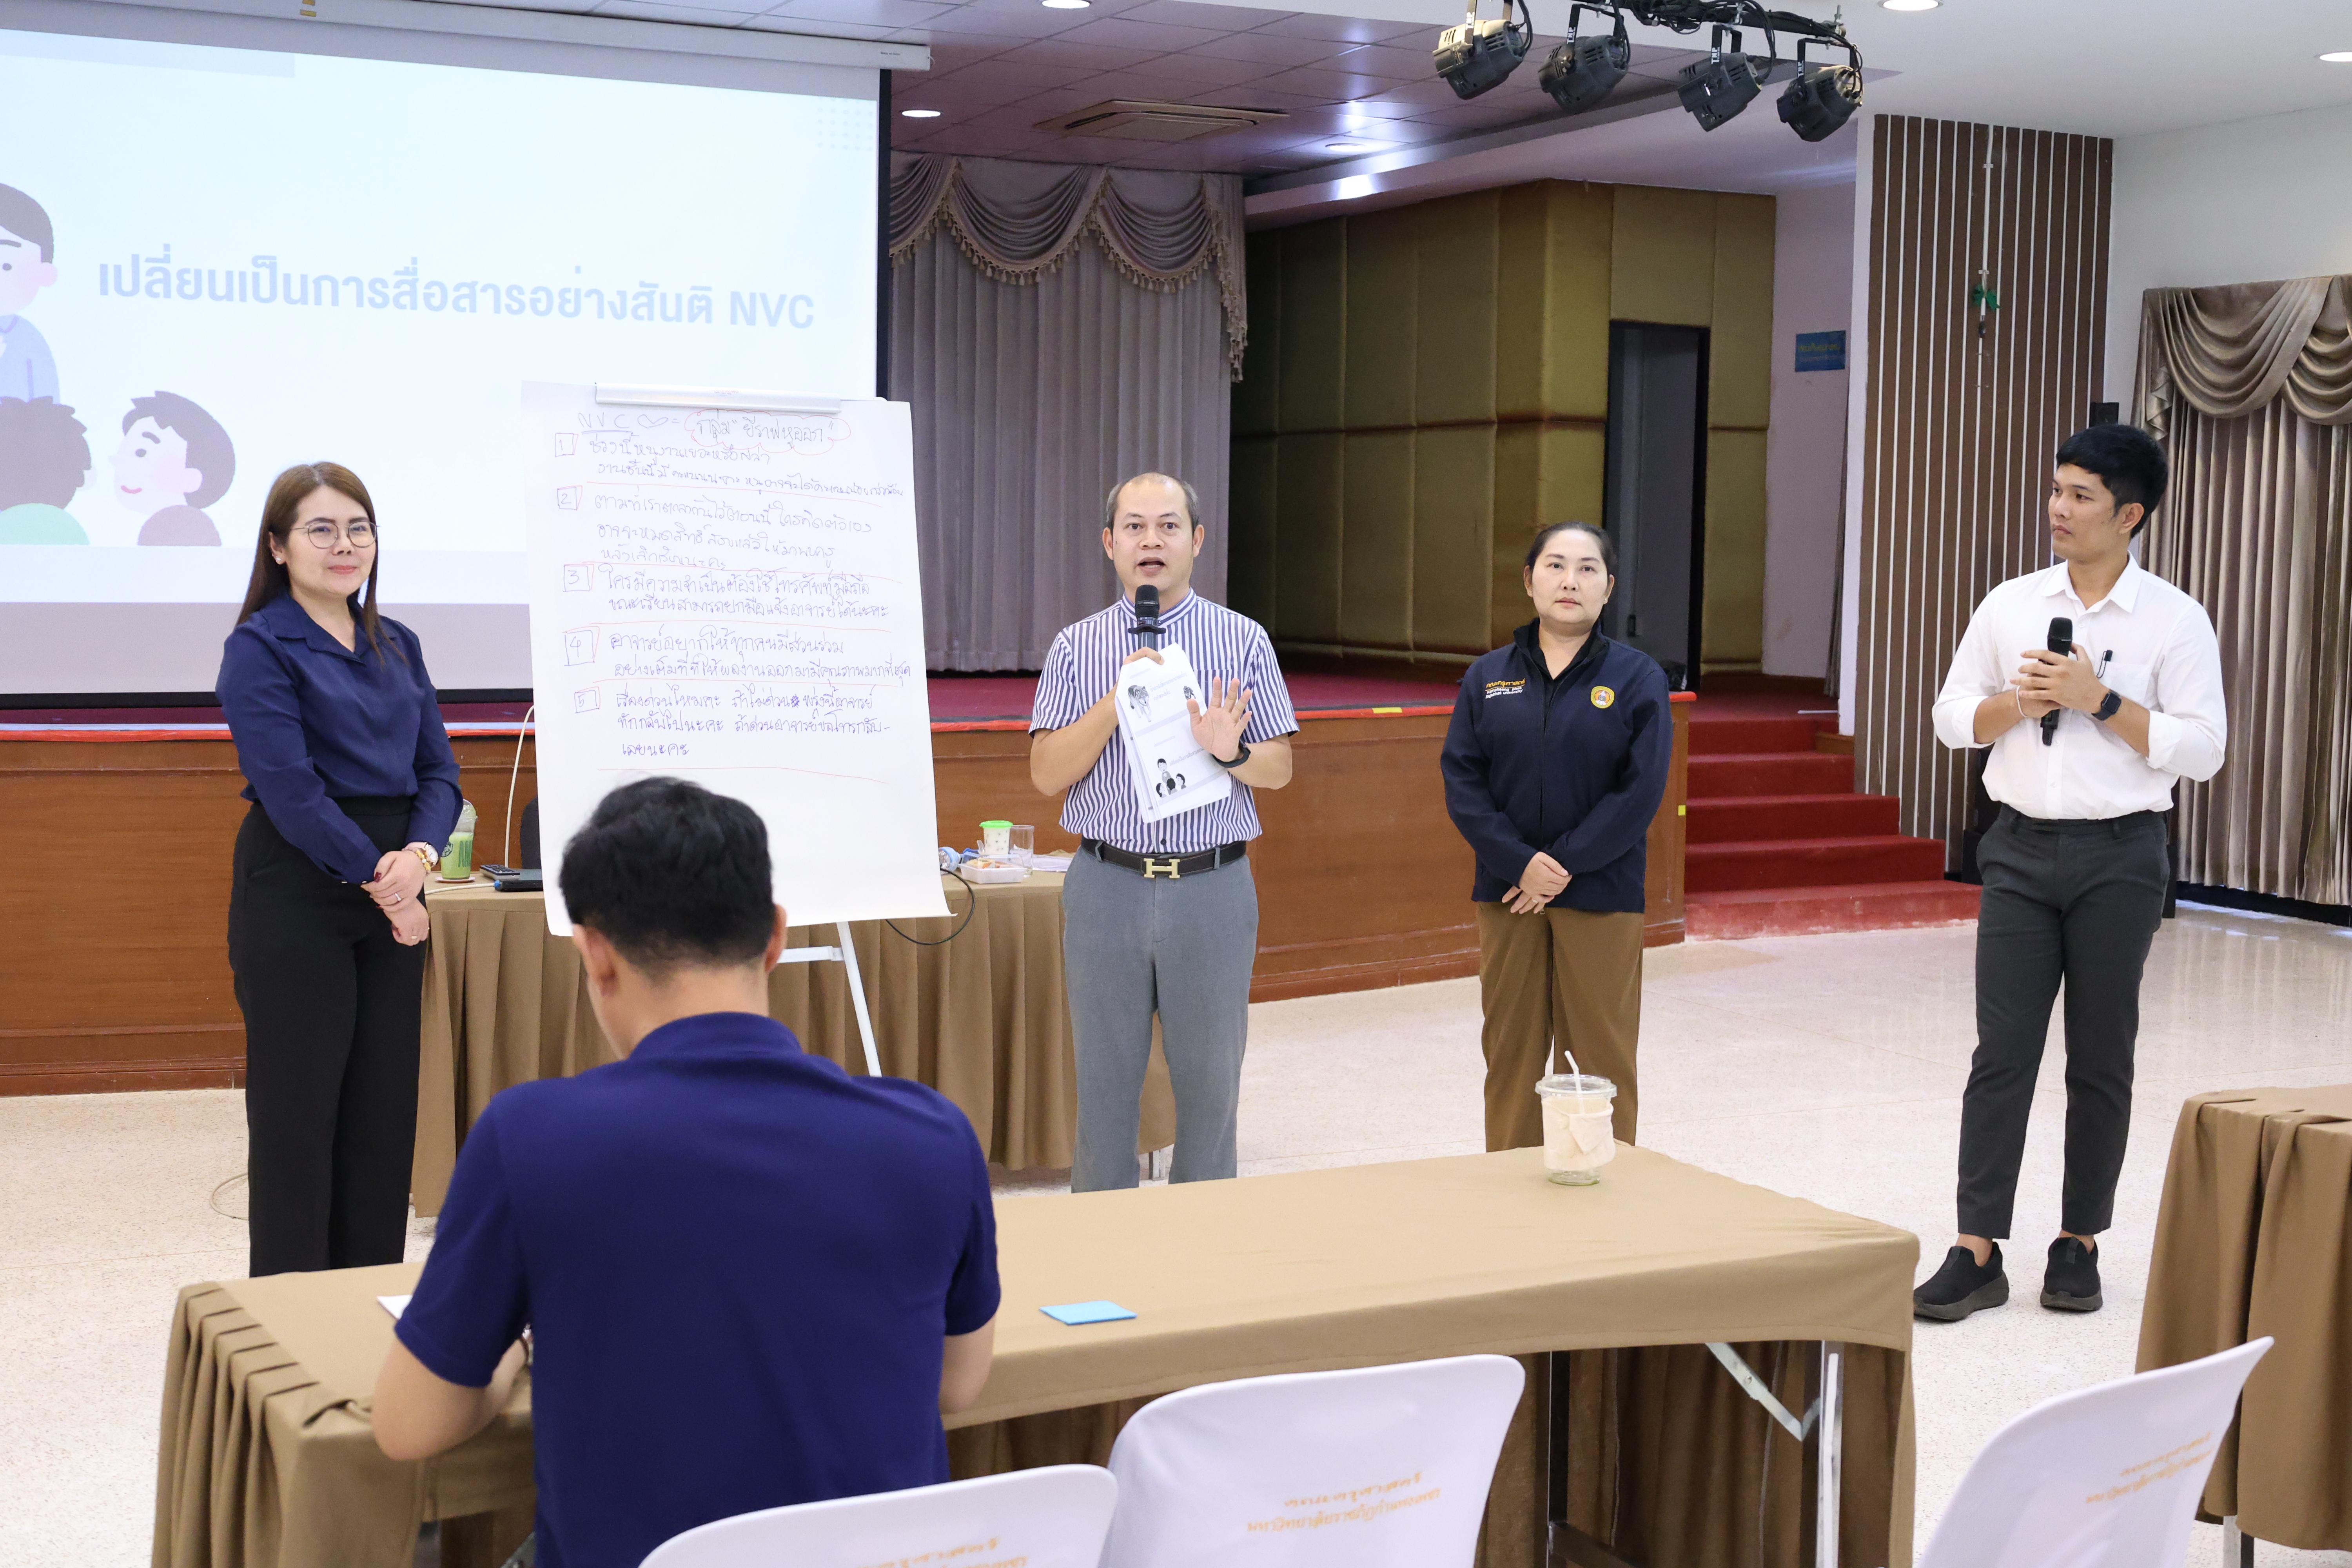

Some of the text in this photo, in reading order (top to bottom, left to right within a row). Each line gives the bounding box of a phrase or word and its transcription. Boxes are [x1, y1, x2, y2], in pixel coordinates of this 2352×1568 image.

[100, 243, 814, 328] เปลี่ยนเป็นการสื่อสารอย่างสันติ NVC
[577, 412, 631, 429] NVC
